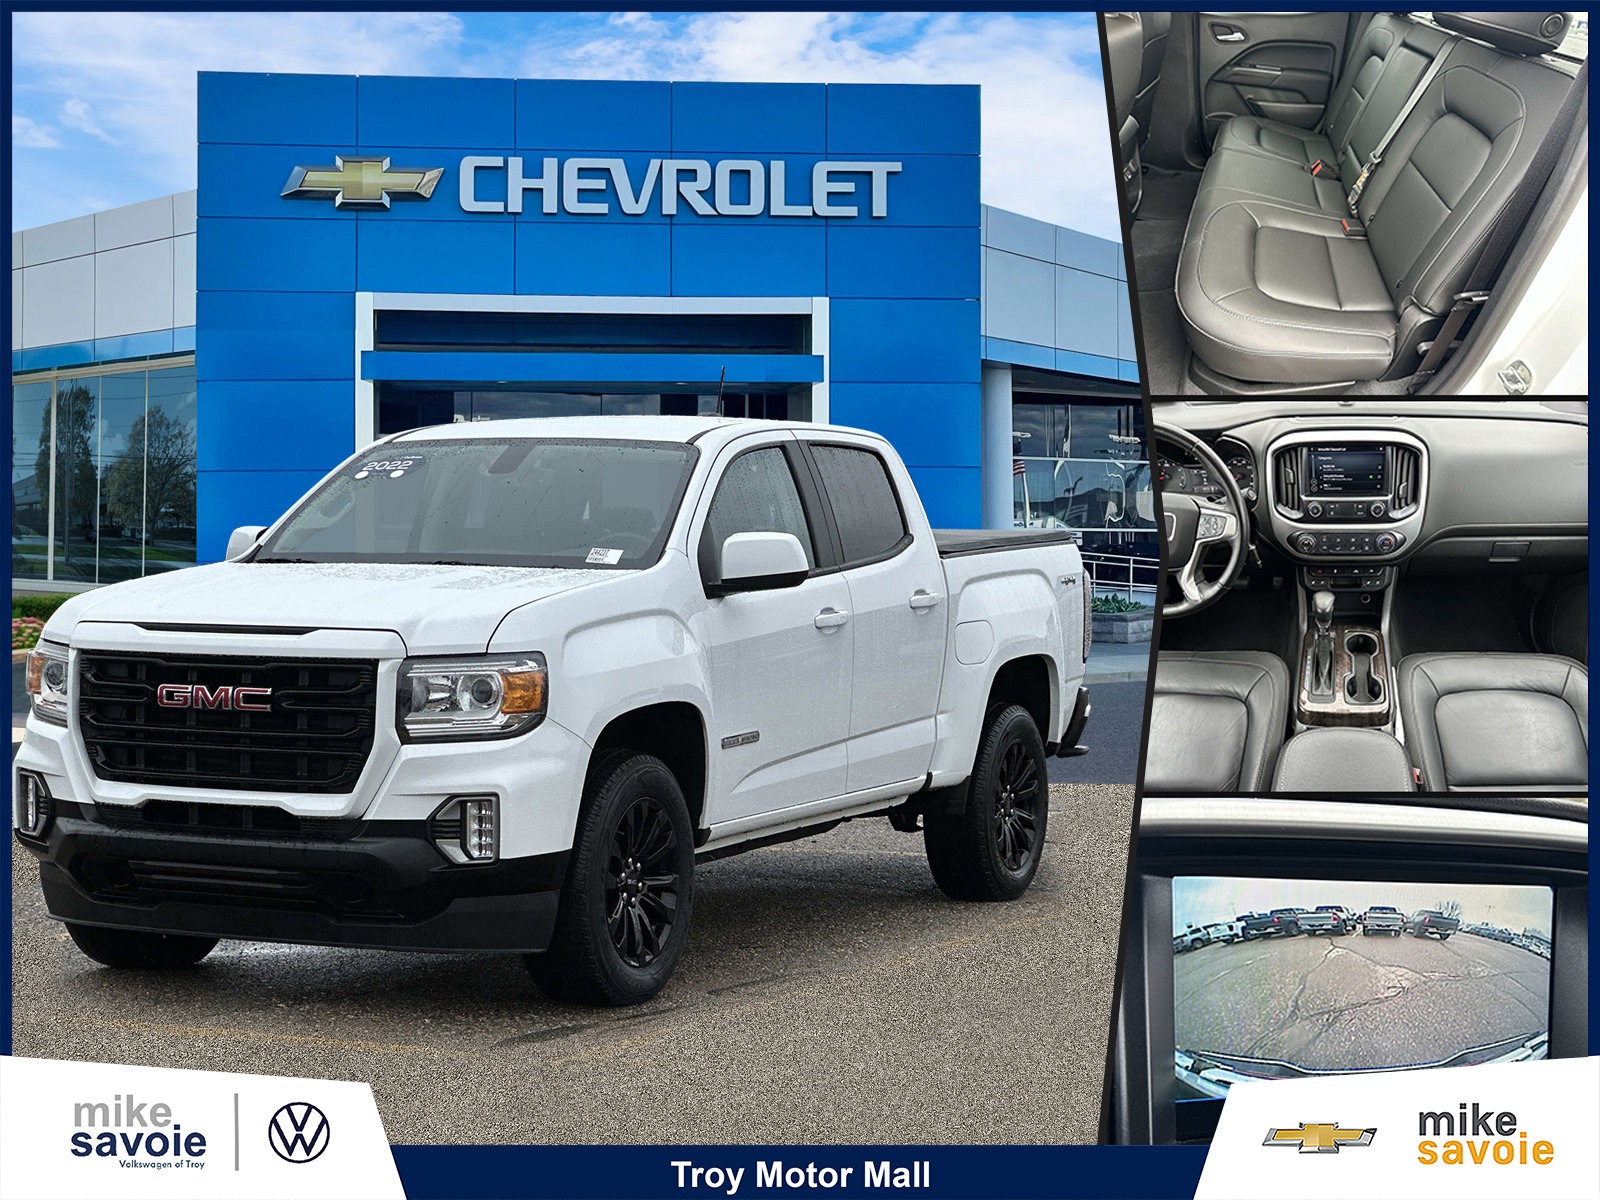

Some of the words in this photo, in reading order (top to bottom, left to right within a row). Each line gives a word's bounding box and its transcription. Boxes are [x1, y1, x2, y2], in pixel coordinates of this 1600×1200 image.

[459, 156, 902, 218] CHEVROLET
[362, 460, 413, 471] 2022
[157, 683, 272, 712] GMC
